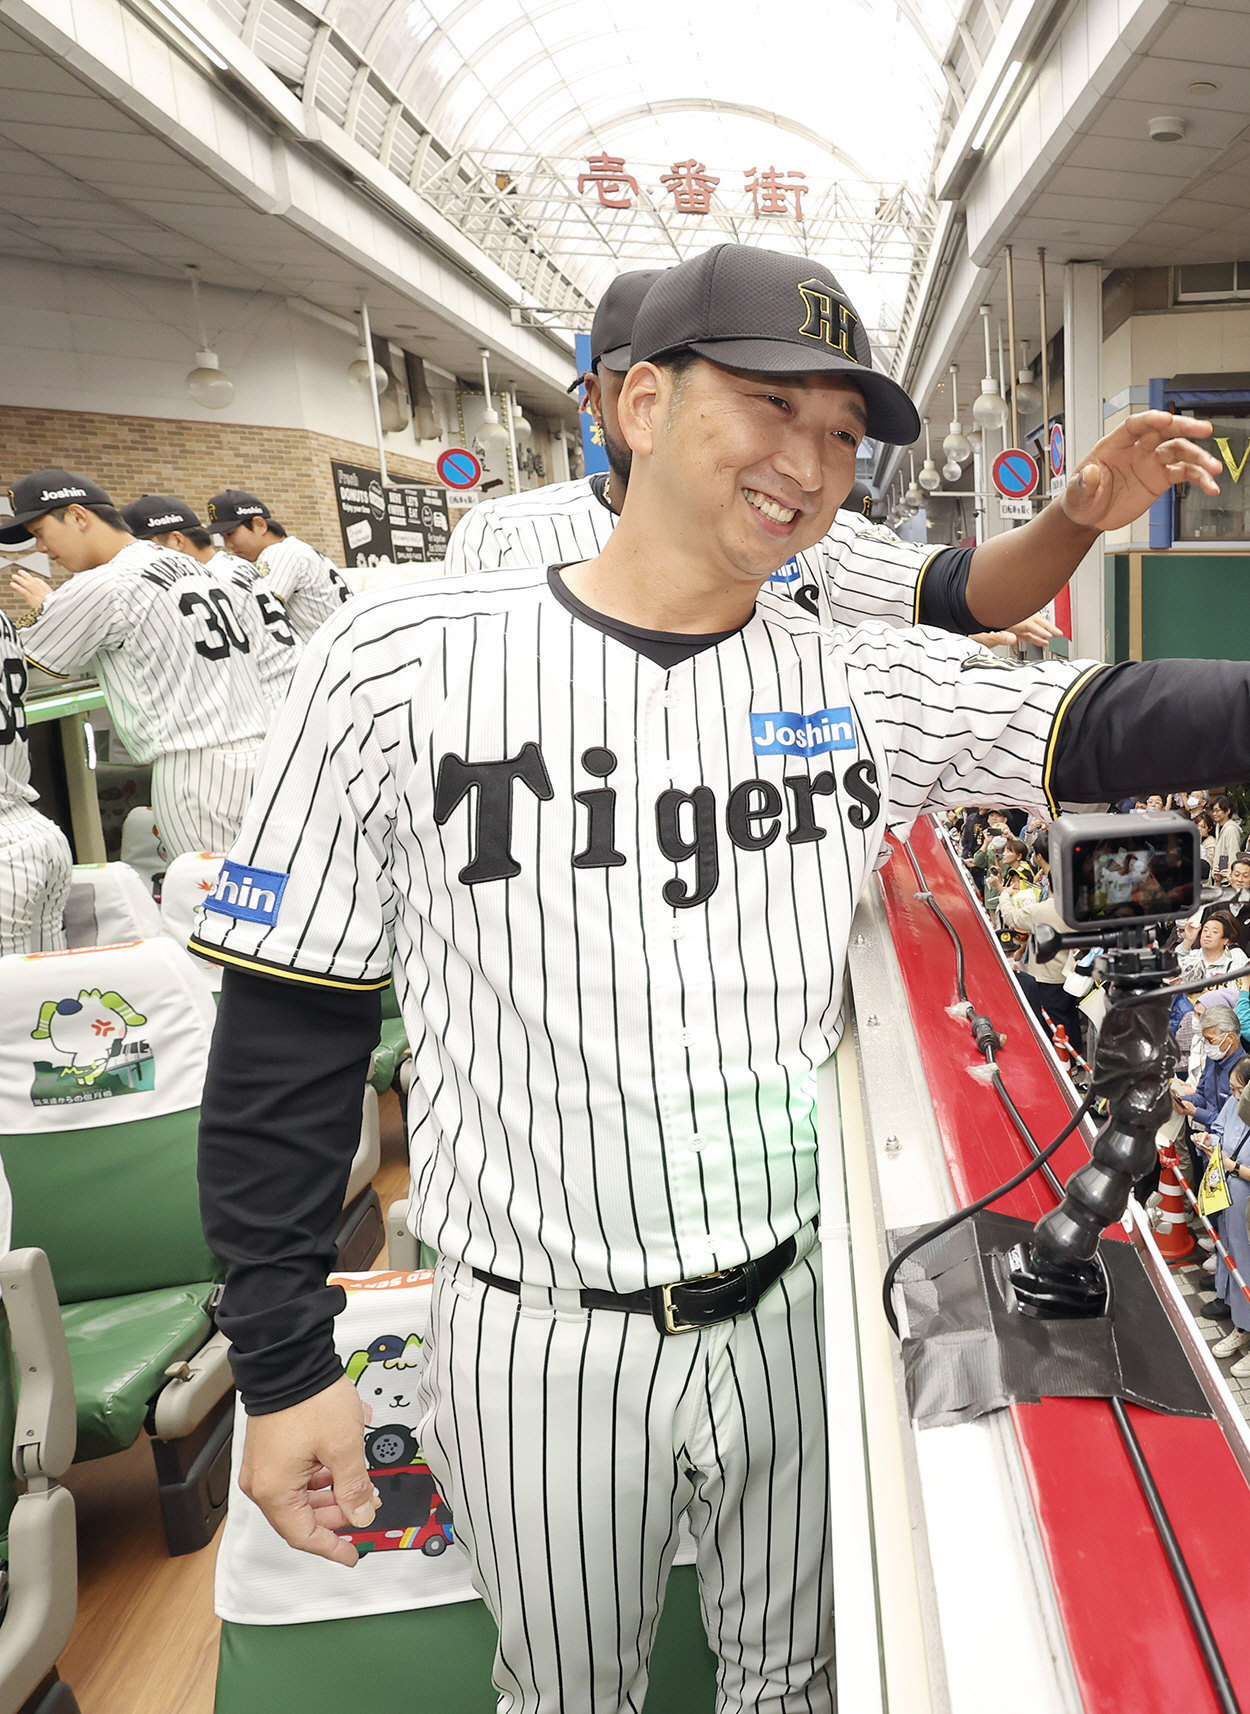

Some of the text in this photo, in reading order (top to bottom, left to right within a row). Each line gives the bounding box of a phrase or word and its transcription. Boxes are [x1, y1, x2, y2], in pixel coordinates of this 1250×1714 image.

[578, 150, 808, 223] 壱番街
[40, 487, 86, 501] Joshin
[235, 505, 264, 516] Joshin
[147, 513, 183, 527] Joshin
[178, 588, 251, 661] 30
[753, 717, 853, 751] Joshin
[433, 741, 881, 909] Tigers
